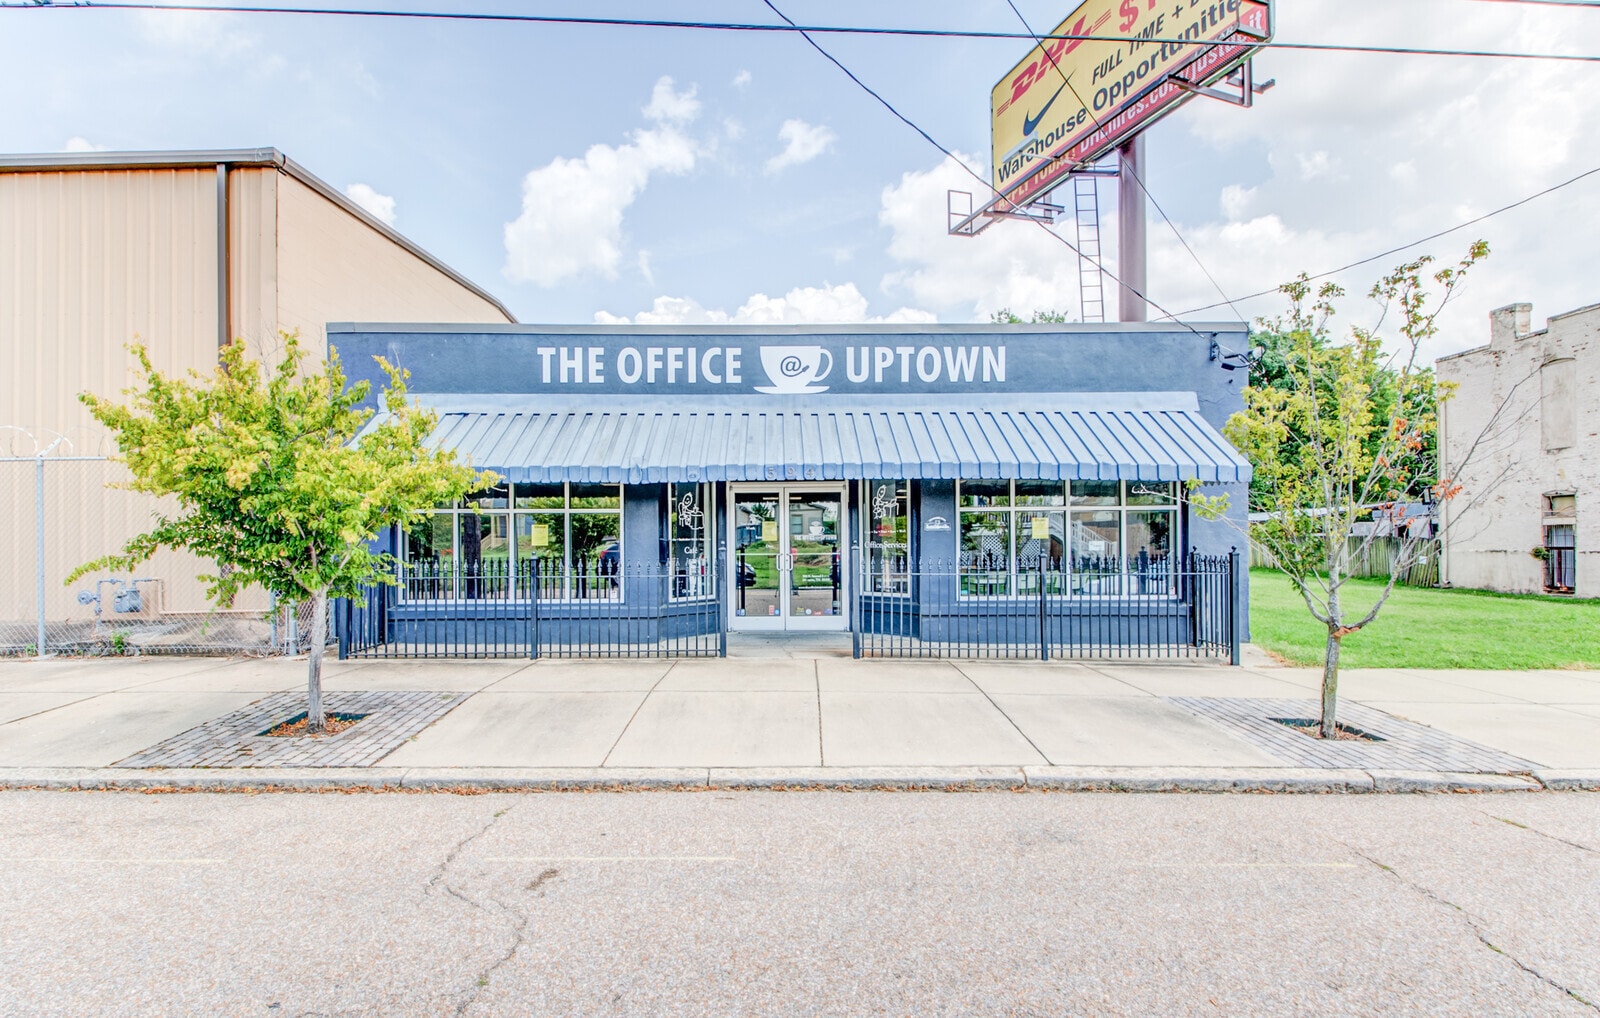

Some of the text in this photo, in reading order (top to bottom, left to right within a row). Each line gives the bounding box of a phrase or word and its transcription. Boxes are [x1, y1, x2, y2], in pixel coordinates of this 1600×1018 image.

[1009, 14, 1093, 106] DHL
[1092, 48, 1123, 86] FULL
[1129, 13, 1165, 56] TIME
[998, 107, 1087, 183] Warehouse
[537, 346, 604, 384] THE
[616, 346, 742, 385] OFFICE
[845, 346, 1007, 384] UPTOWN
[864, 541, 907, 551] Office Services
